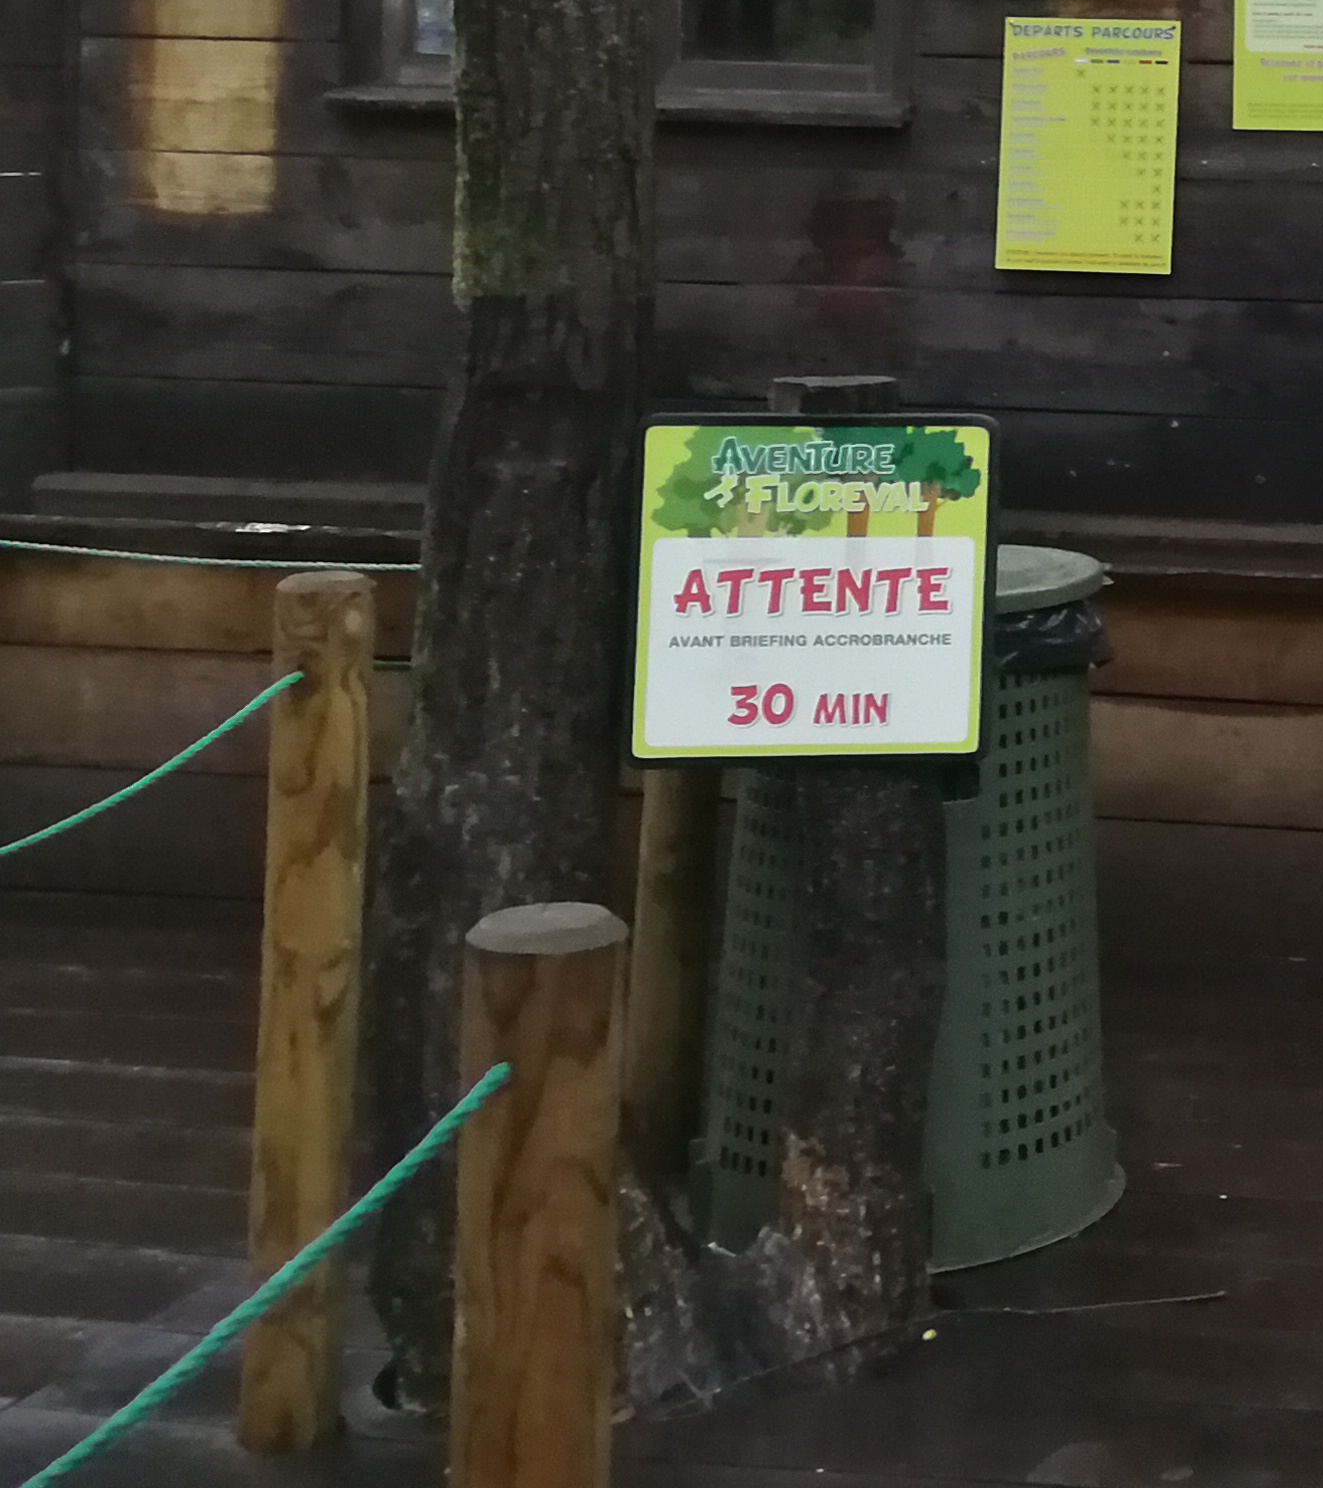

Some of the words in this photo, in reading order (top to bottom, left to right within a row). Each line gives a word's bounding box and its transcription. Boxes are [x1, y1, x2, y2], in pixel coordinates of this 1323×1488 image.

[1012, 24, 1083, 38] DEPARTS
[1091, 26, 1174, 40] PARCOURS
[711, 437, 896, 476] AVENTURE
[745, 474, 929, 513] FLOREVAL
[673, 567, 951, 615] ATTENTE
[668, 635, 724, 648] AVANT
[730, 635, 807, 648] BRIEFING
[813, 633, 952, 647] ACCROBRANCHE
[727, 683, 795, 726] 30
[812, 693, 890, 726] MIN
